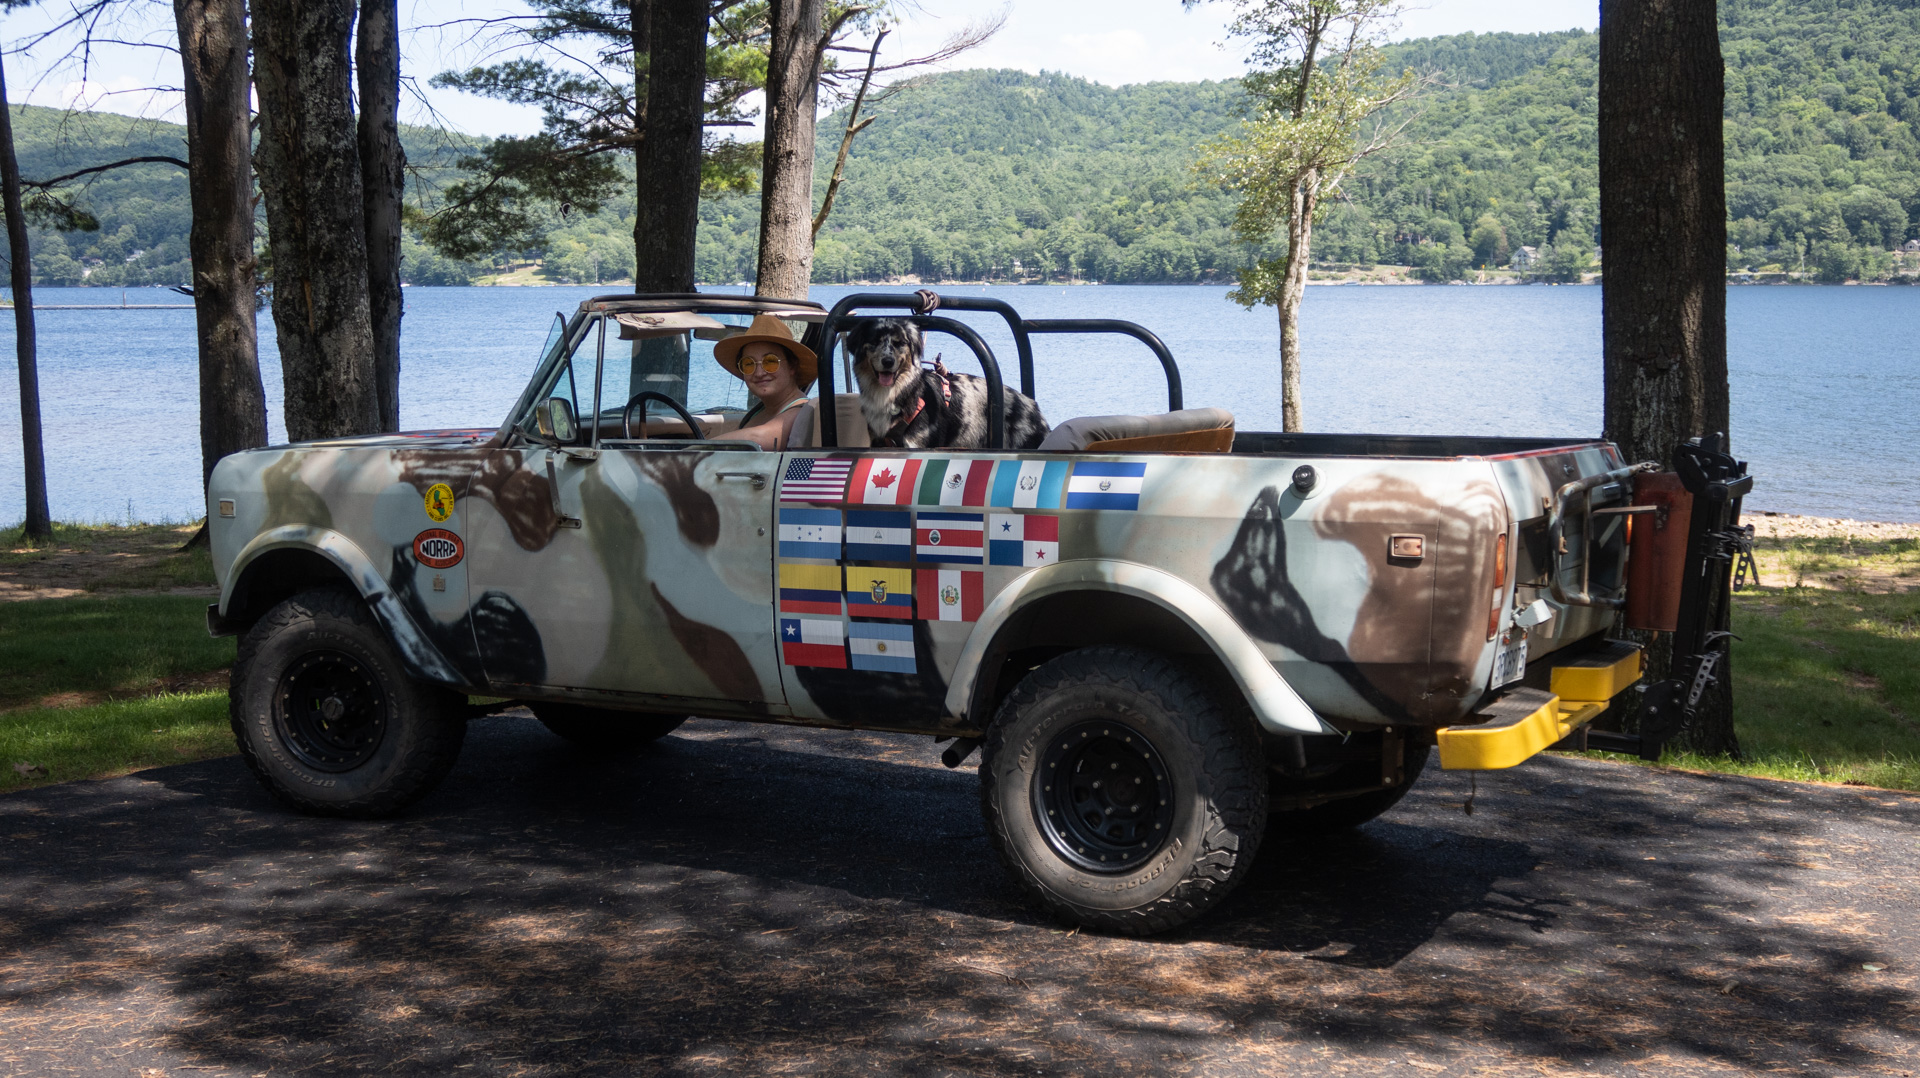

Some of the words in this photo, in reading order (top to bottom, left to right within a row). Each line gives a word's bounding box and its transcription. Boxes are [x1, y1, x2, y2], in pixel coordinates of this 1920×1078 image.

[417, 530, 436, 542] NATIONAL
[448, 533, 460, 544] ROAD
[422, 540, 456, 558] NORRA
[417, 552, 432, 565] RACING
[434, 554, 460, 567] ASSOCIATION
[1117, 703, 1149, 726] T/A
[258, 714, 337, 789] BFGoodrich
